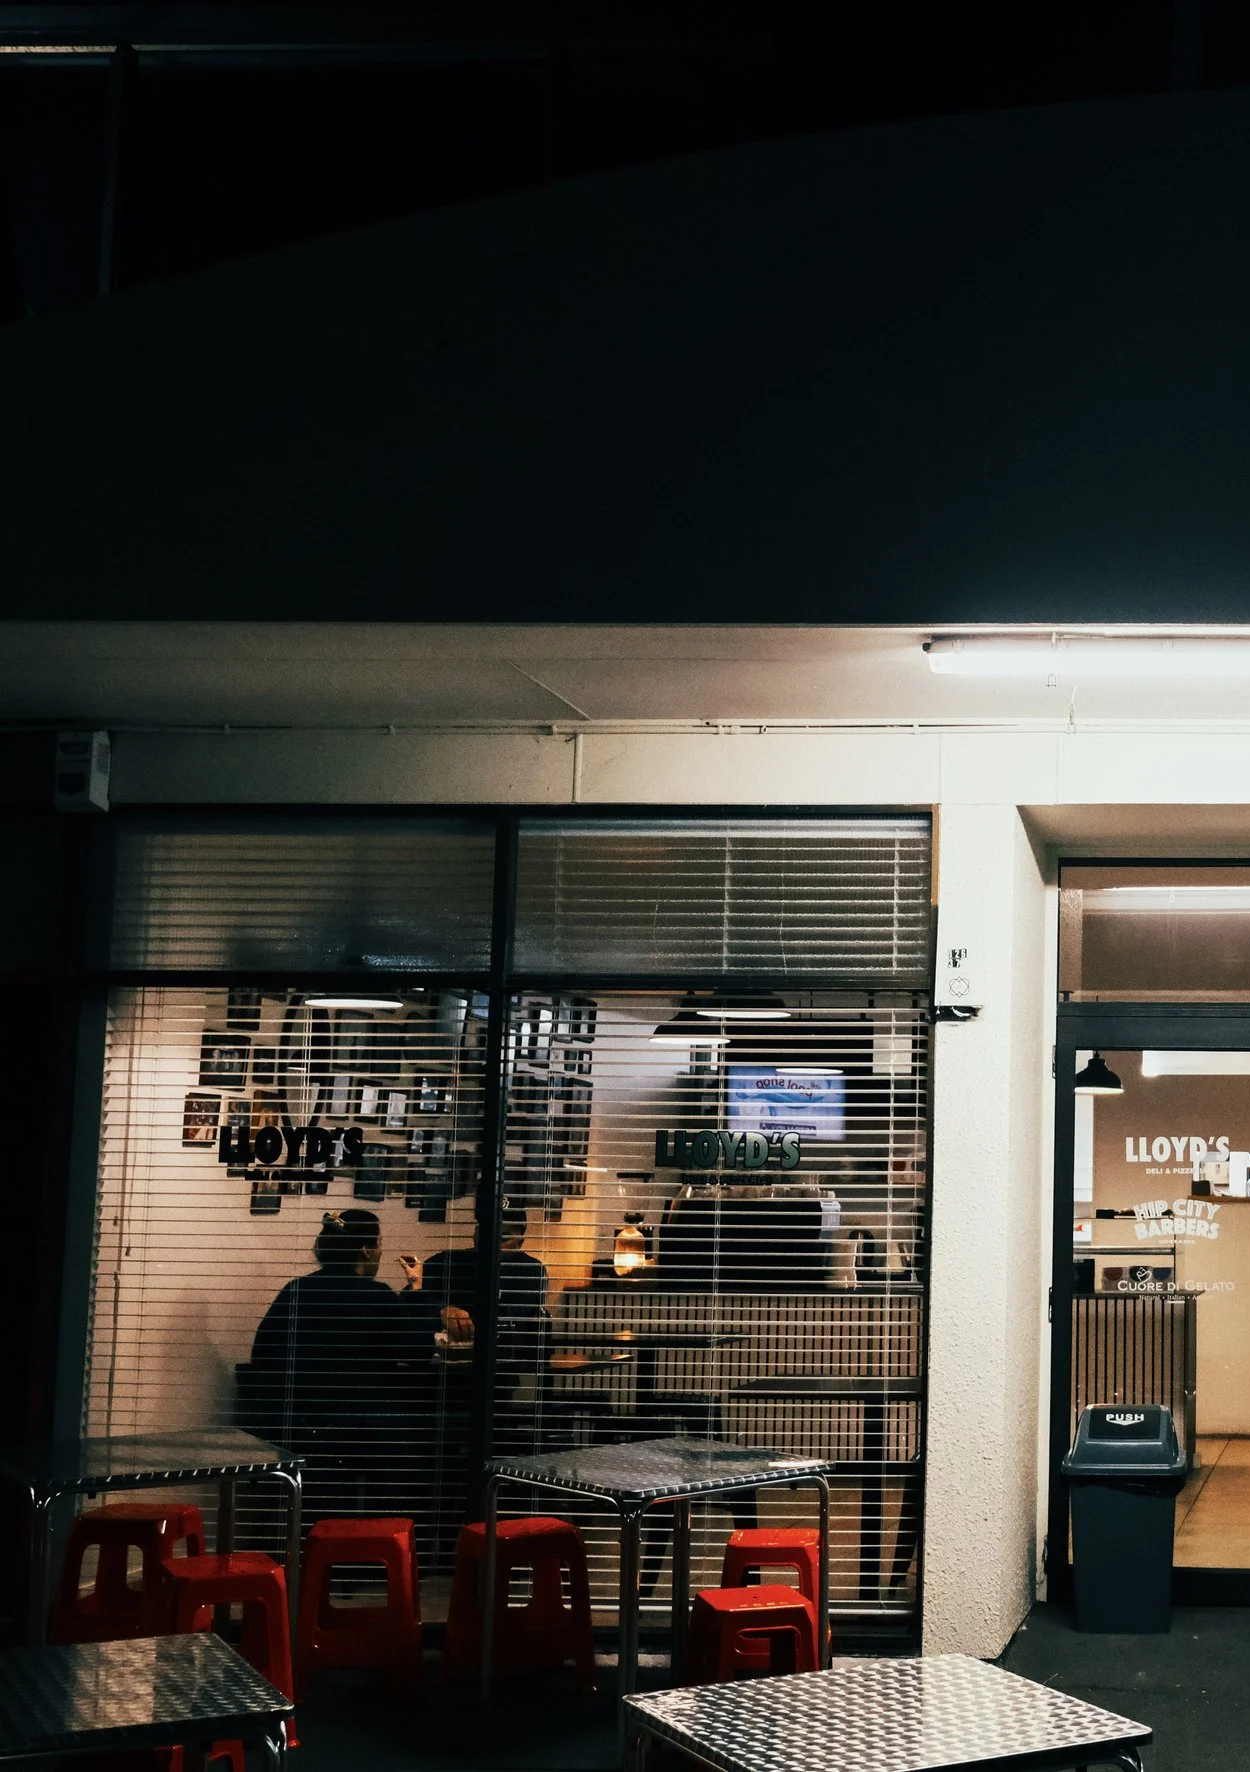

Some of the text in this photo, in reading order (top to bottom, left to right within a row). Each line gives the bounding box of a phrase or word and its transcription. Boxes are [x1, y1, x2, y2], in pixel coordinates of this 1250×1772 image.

[218, 1126, 364, 1166] LLOYD'S
[655, 1130, 801, 1169] LLOYD'S
[1125, 1136, 1230, 1162] LLOYD'S
[1133, 1199, 1220, 1222] HIP CITY
[1133, 1218, 1220, 1240] BARBERS
[1105, 1413, 1145, 1421] PUSH
